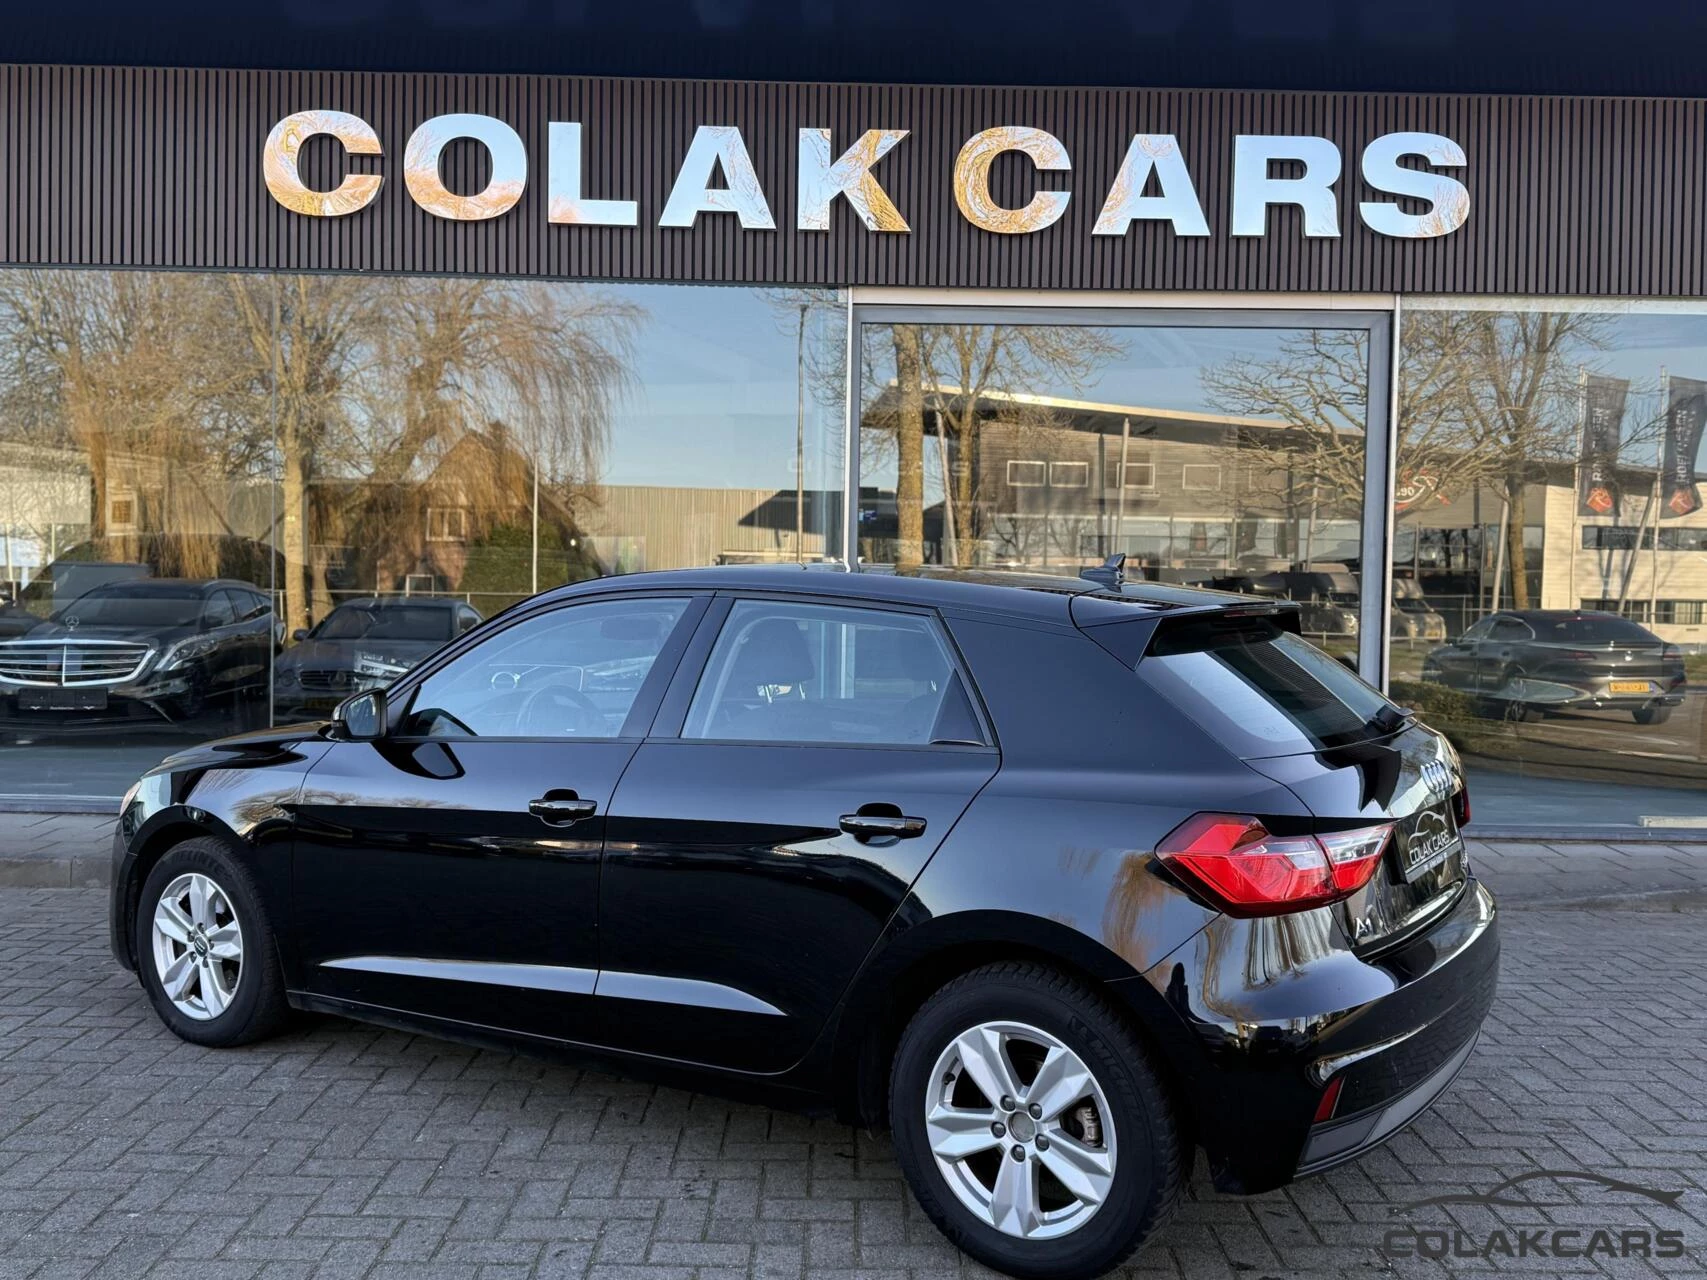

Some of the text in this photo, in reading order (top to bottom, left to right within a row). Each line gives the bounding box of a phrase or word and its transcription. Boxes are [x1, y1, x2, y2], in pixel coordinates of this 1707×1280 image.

[262, 109, 1472, 240] COLAK CARS
[1409, 841, 1433, 865] COLAK
[1432, 829, 1450, 850] CARS
[1355, 917, 1373, 939] A1
